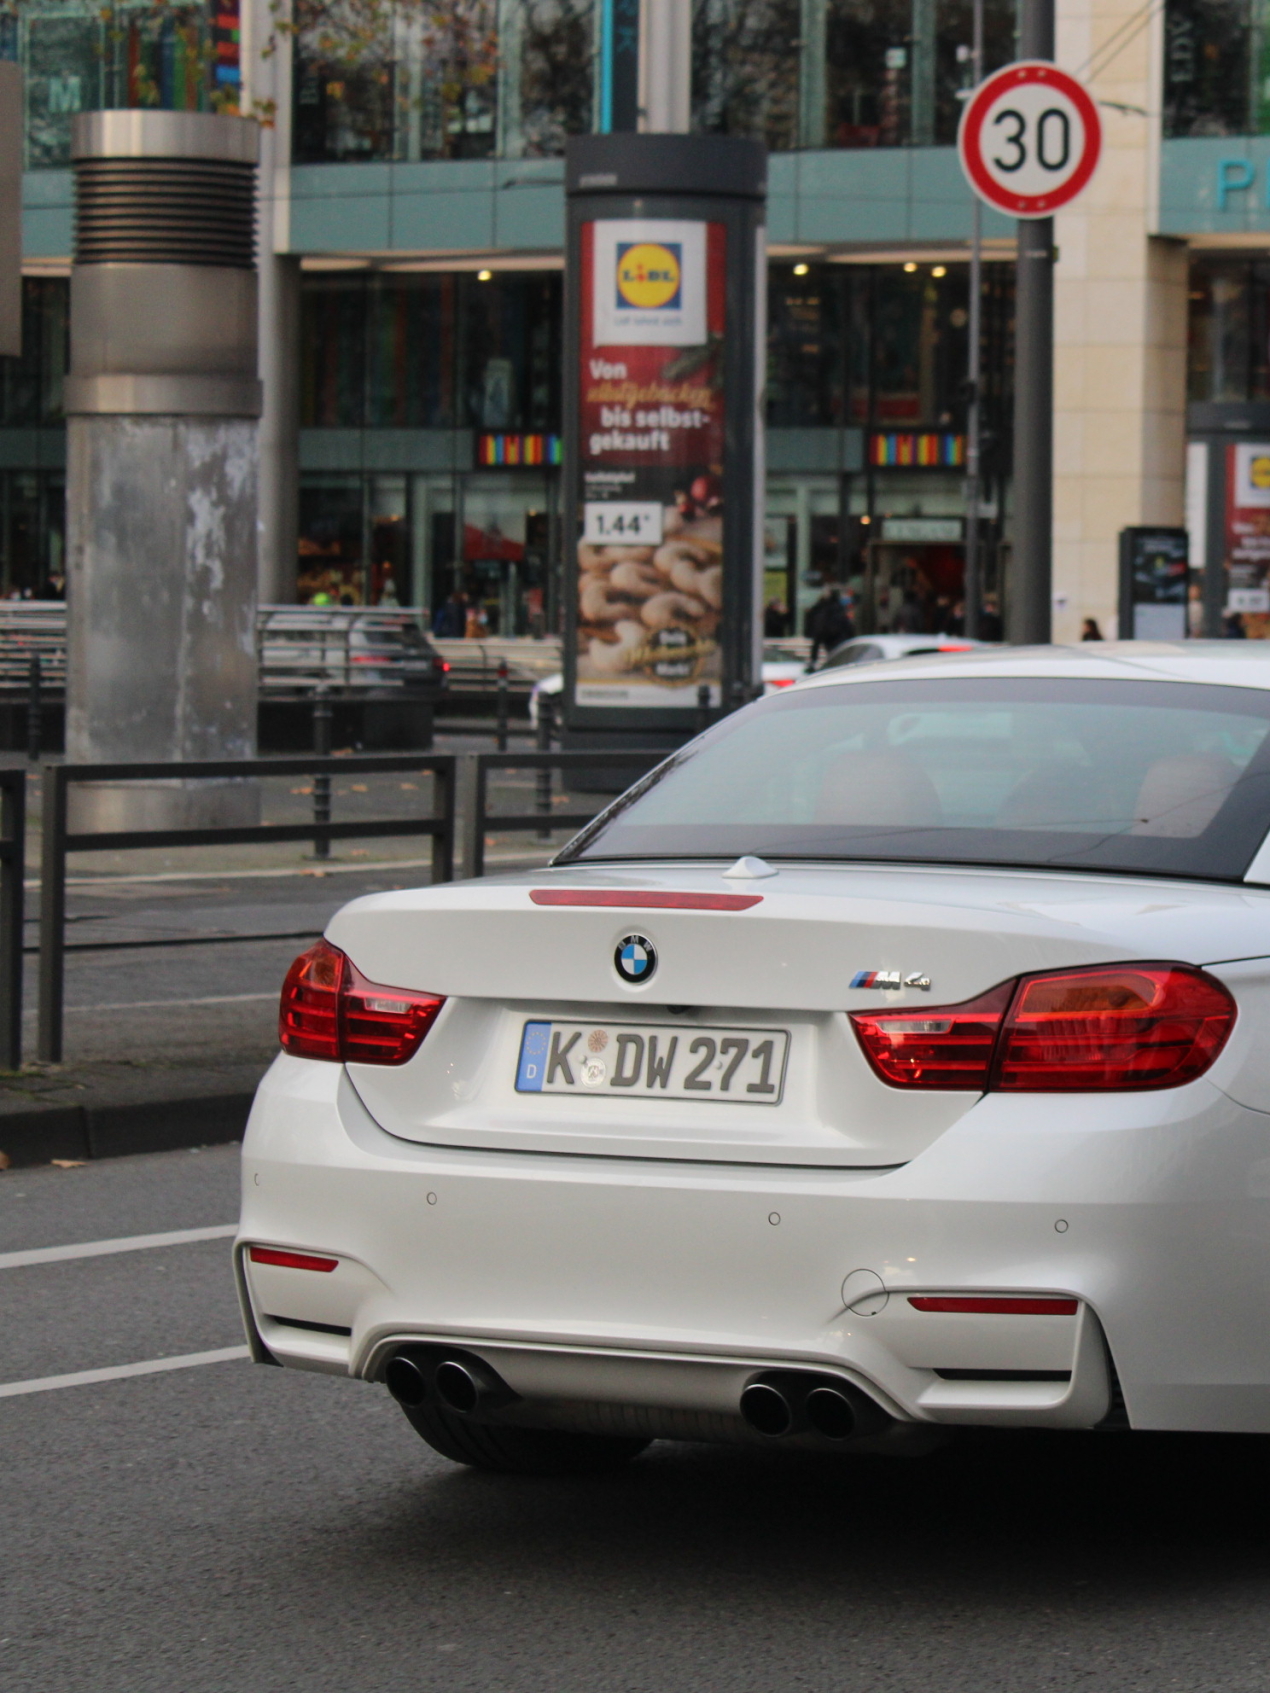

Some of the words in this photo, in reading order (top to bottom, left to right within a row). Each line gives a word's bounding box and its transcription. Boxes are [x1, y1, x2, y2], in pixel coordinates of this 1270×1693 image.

[993, 108, 1070, 172] 30
[589, 359, 627, 379] Von
[601, 405, 631, 428] bis
[635, 406, 709, 429] selbst-
[589, 430, 670, 455] gekauft
[618, 934, 653, 952] BMW
[547, 1031, 582, 1085] K
[526, 1063, 537, 1080] D
